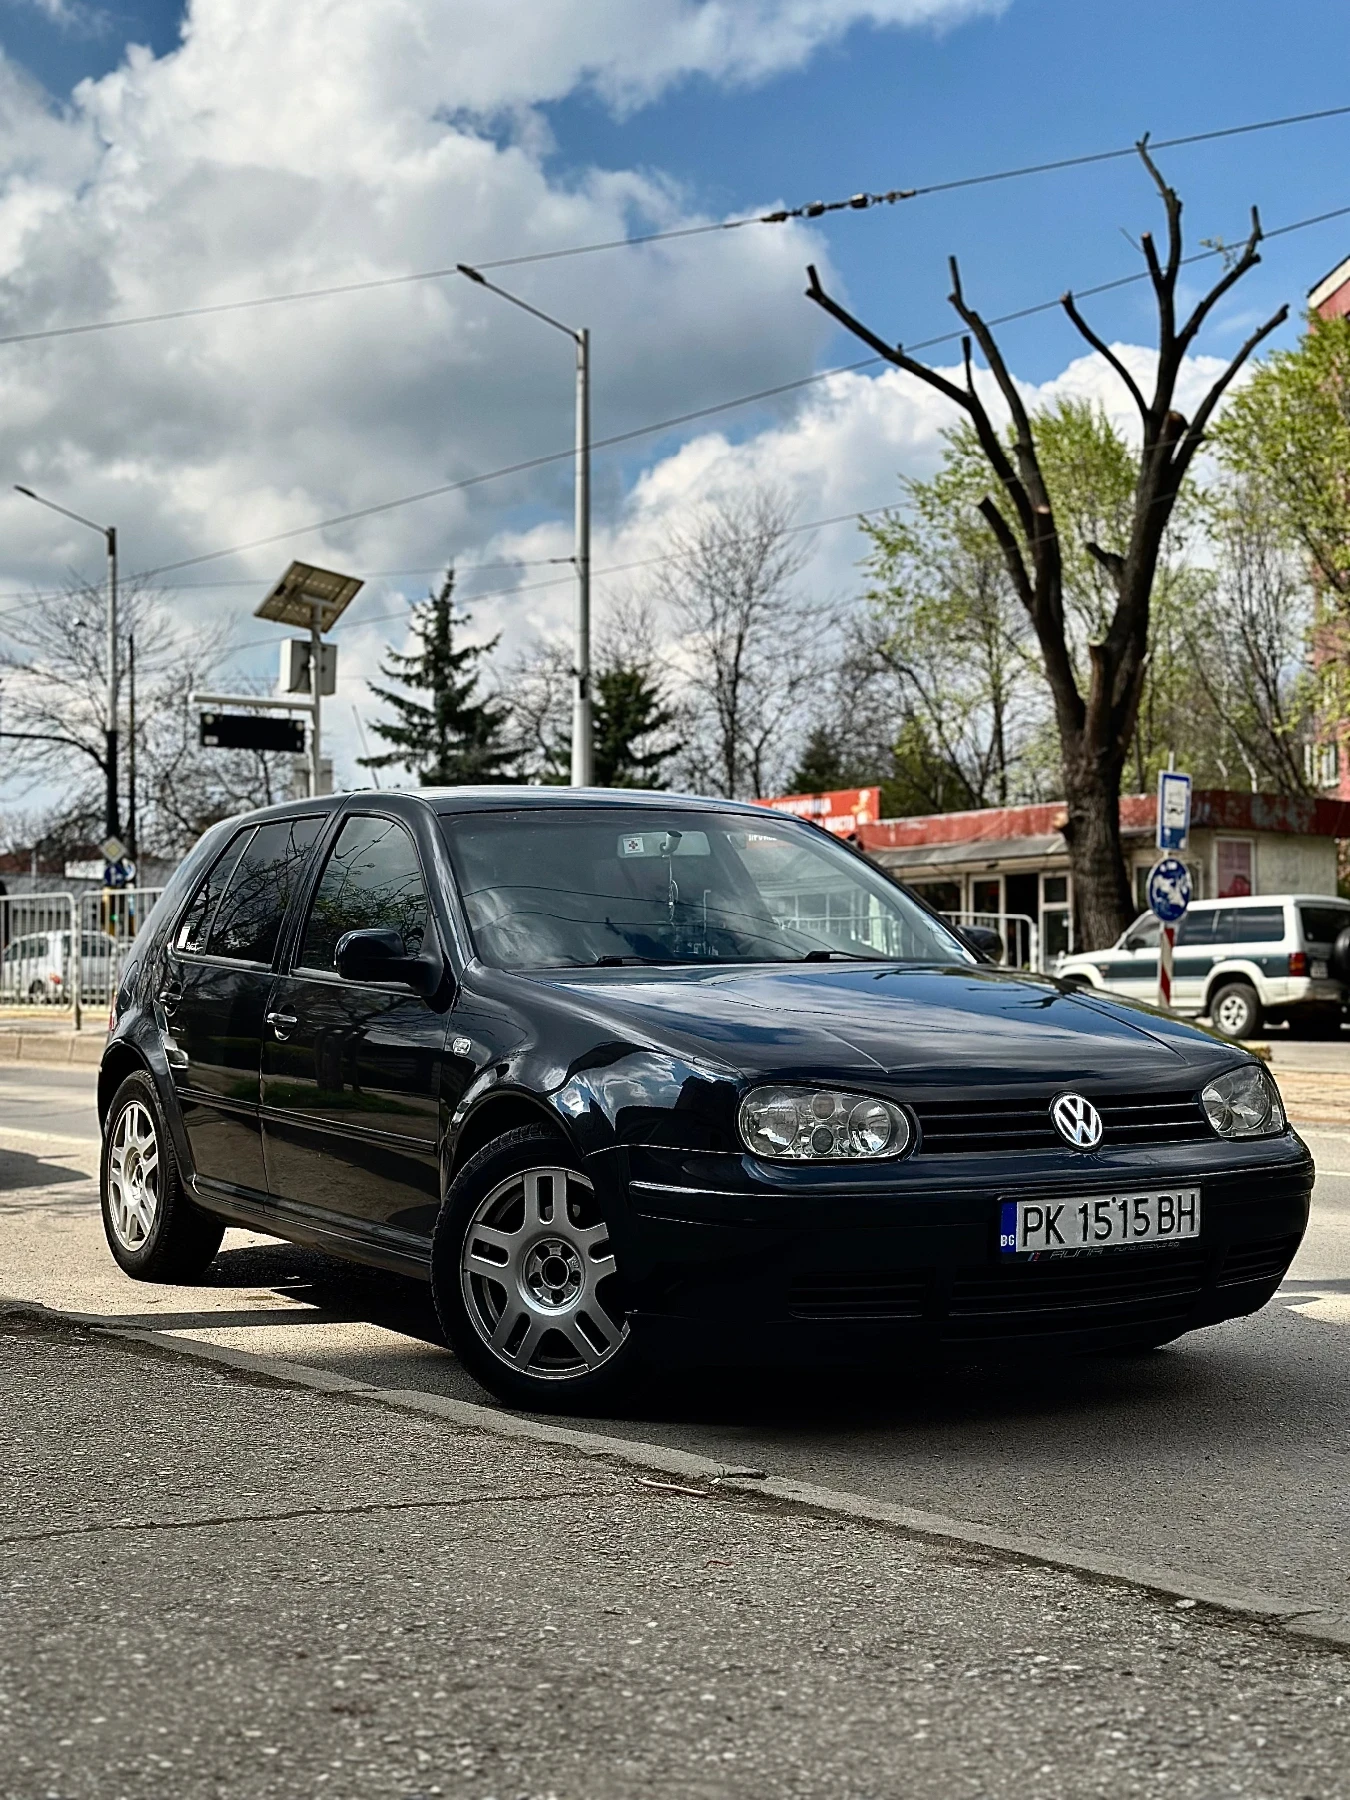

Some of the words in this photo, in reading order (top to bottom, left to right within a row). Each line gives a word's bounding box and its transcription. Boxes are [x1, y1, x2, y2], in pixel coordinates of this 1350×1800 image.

[1023, 1203, 1066, 1247] PK
[1078, 1197, 1151, 1243] 1515
[1157, 1192, 1196, 1236] BH
[1001, 1234, 1015, 1247] BG
